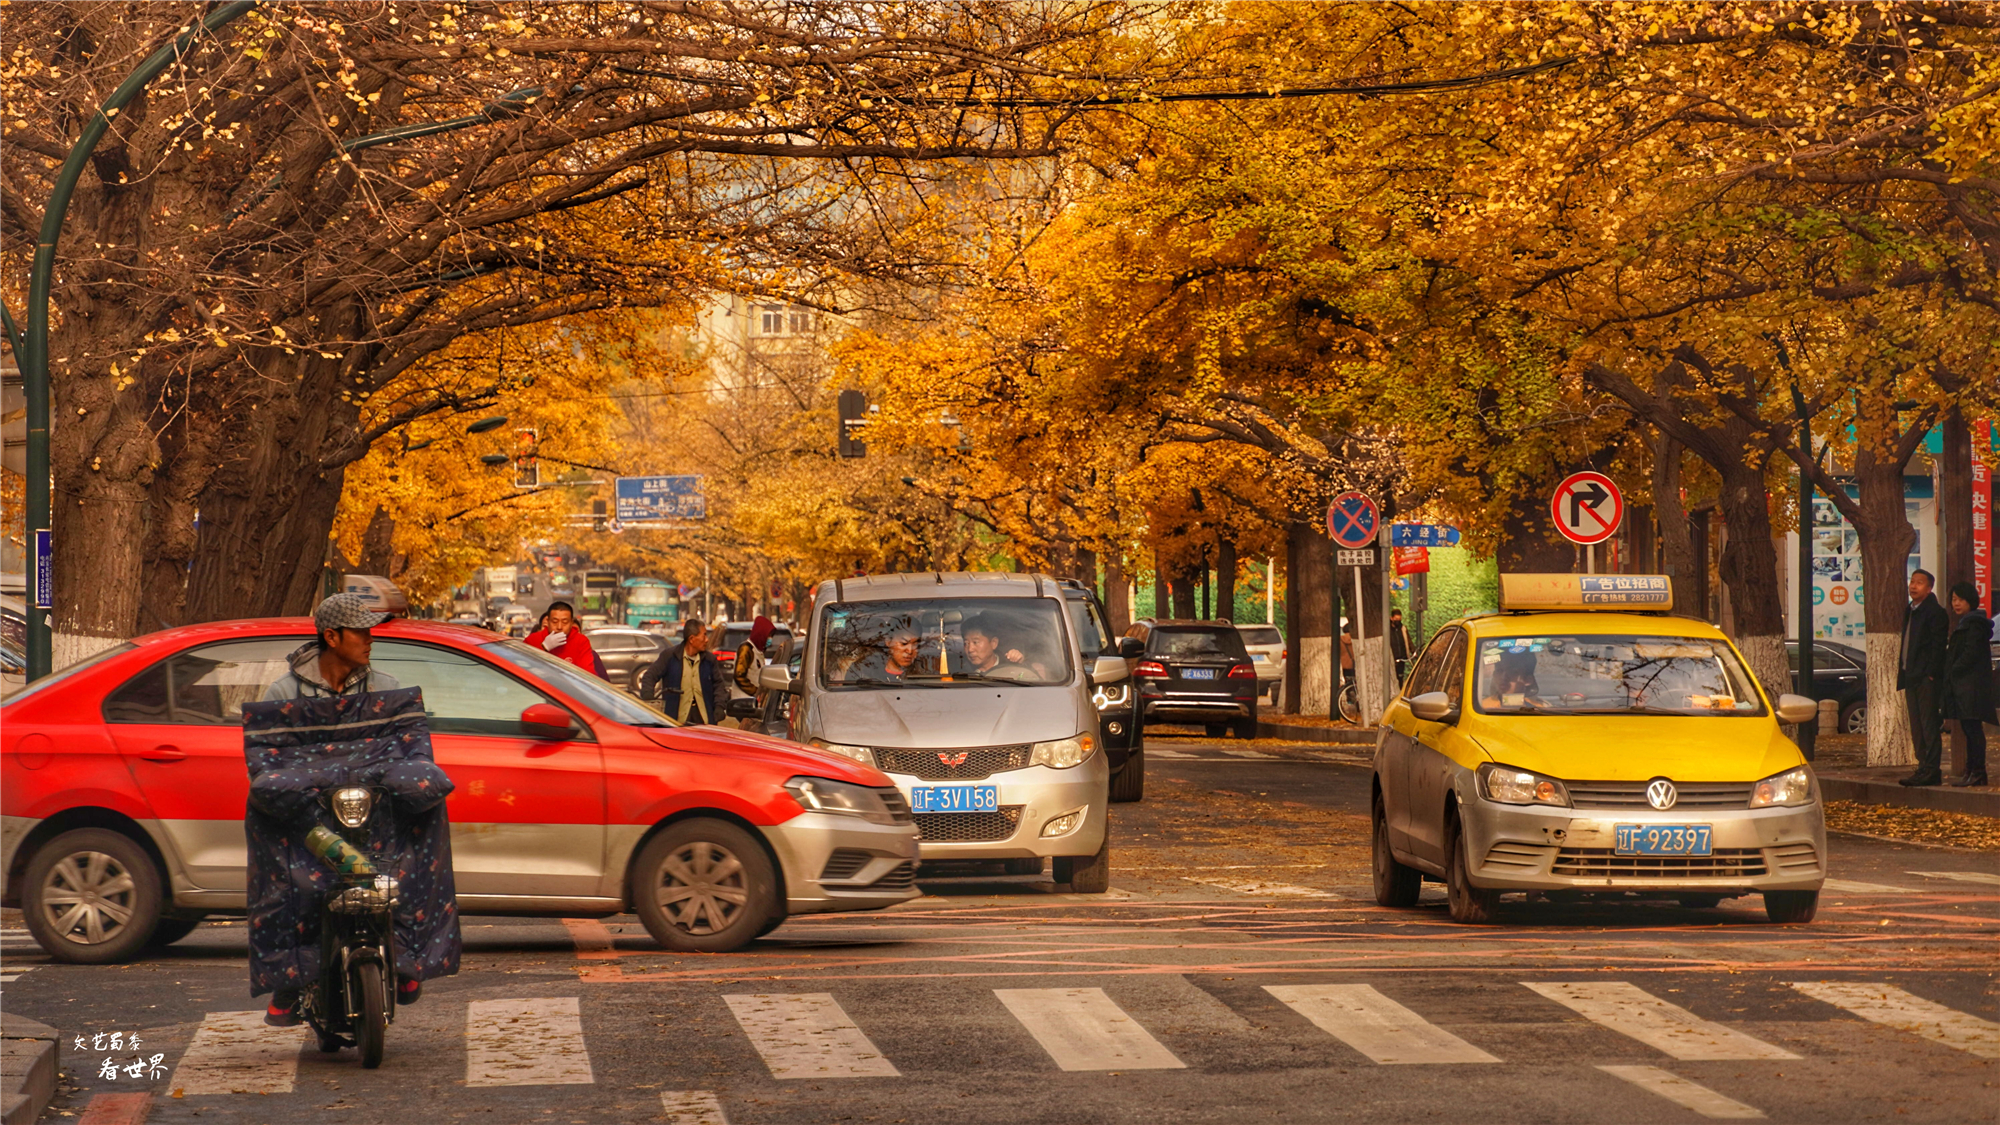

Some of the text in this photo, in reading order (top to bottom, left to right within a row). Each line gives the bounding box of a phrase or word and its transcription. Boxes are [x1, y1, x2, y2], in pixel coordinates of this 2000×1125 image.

[1402, 526, 1448, 539] 六经街
[1581, 577, 1665, 590] 广告位招商
[1592, 593, 1665, 602] 广告热线 2821777
[1617, 828, 1711, 851] 辽F·92397
